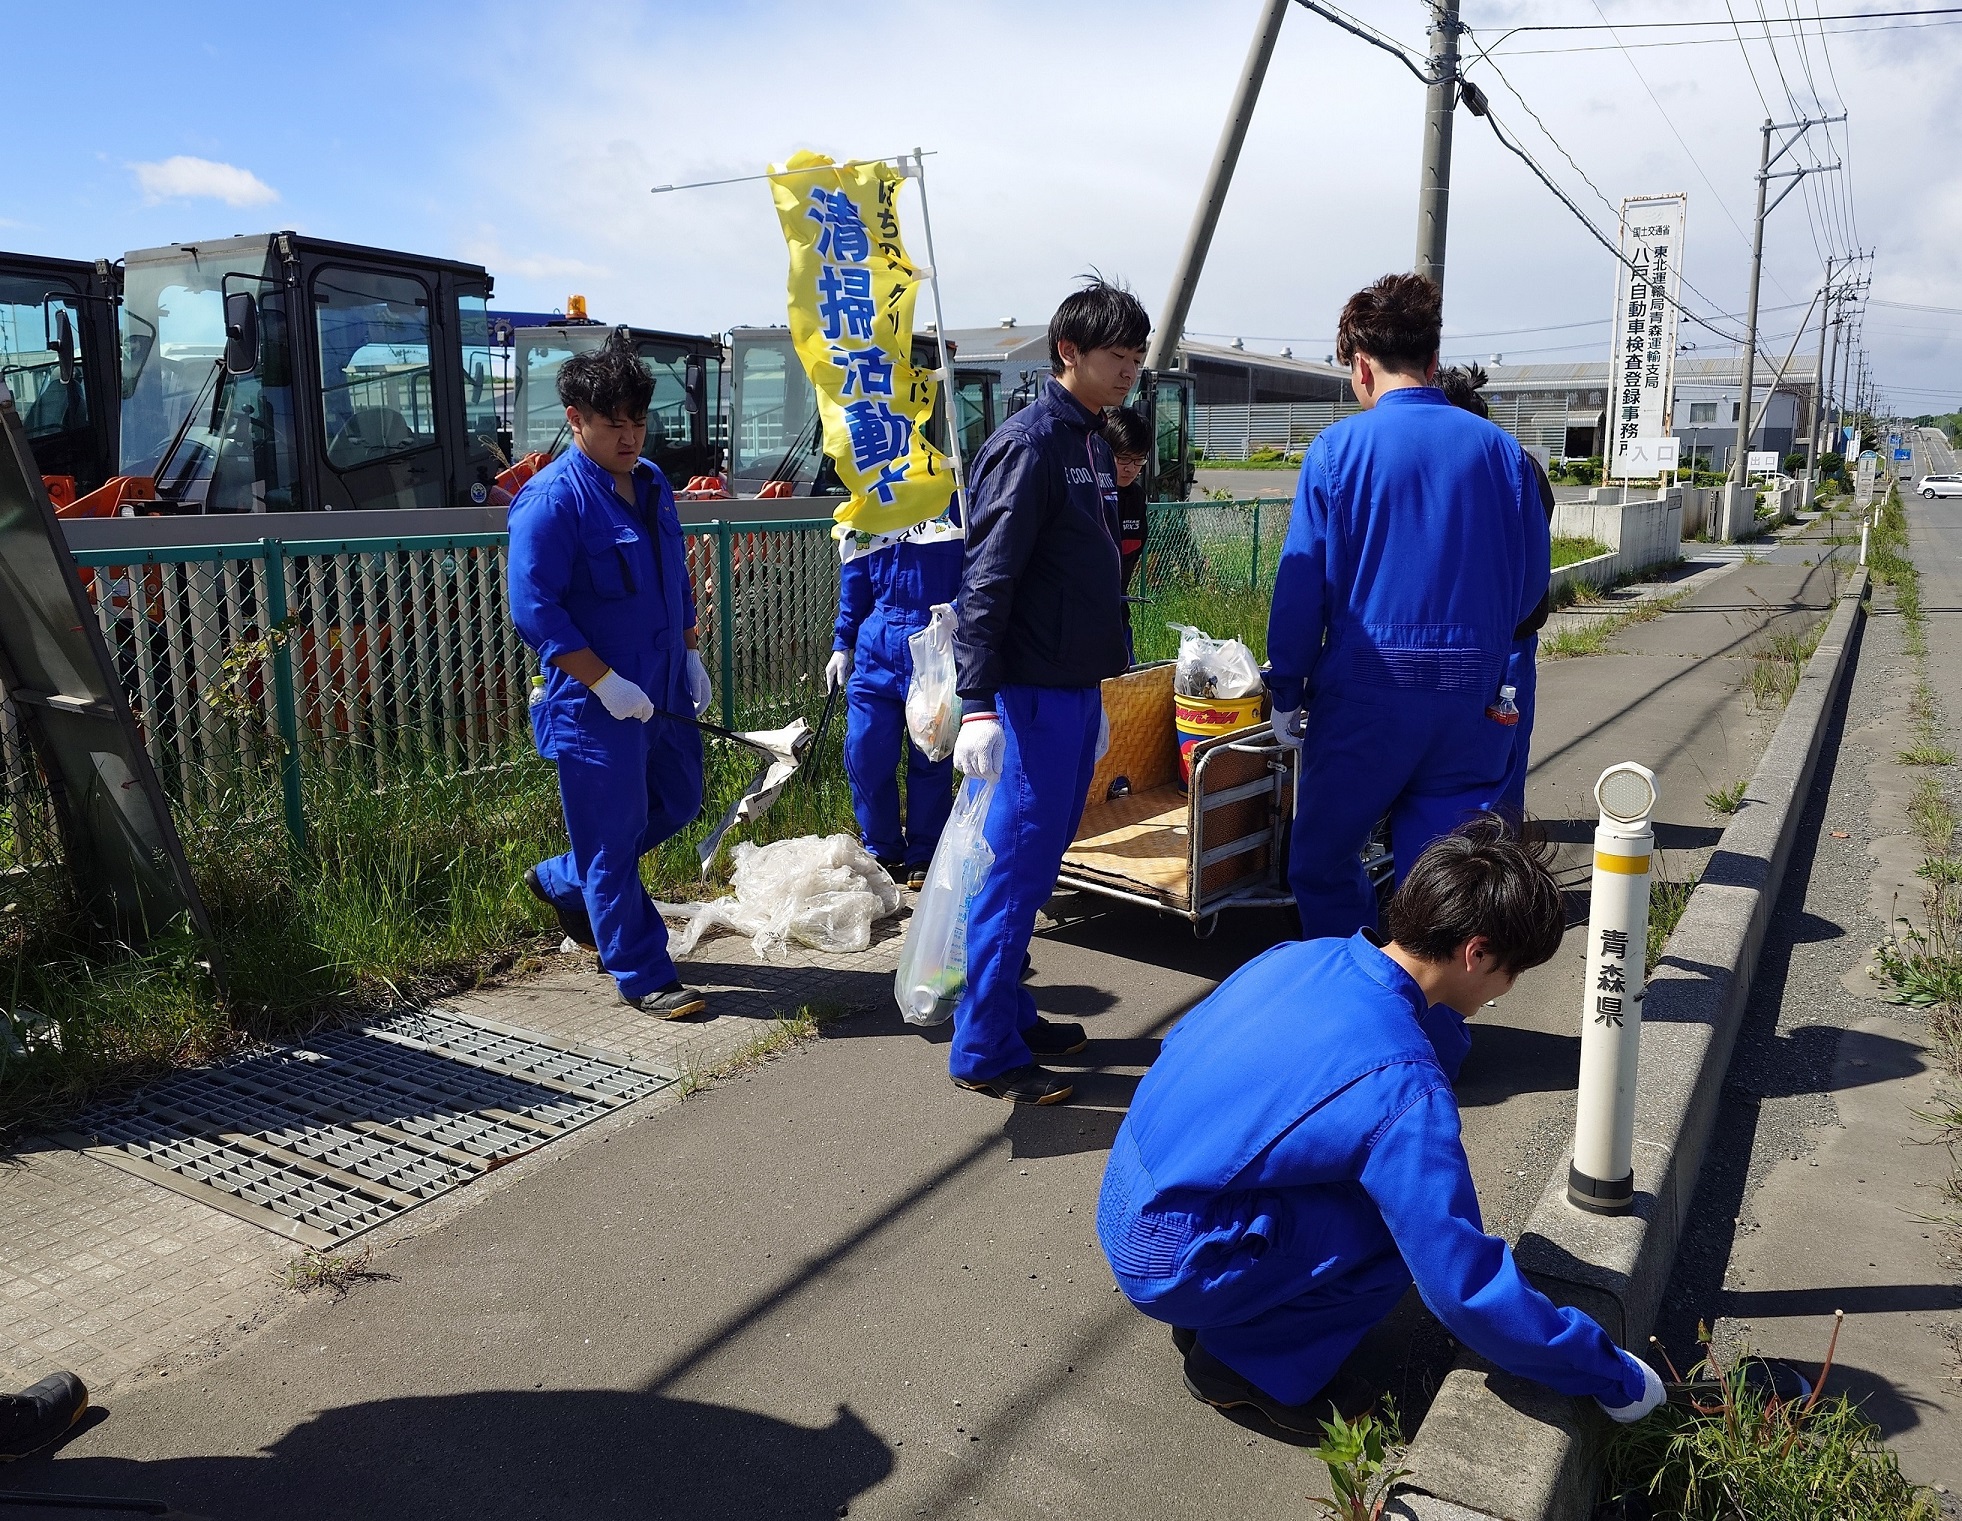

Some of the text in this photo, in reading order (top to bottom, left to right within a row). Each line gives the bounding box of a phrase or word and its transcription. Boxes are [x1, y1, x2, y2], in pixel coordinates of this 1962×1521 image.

[1633, 225, 1671, 238] 国土交通省
[1644, 245, 1669, 389] 東北運輸局青森運輸支局
[1631, 446, 1675, 462] 入口
[1750, 456, 1776, 466] 出口
[1176, 705, 1240, 725] AYTONA
[1594, 929, 1629, 1029] 青森県
